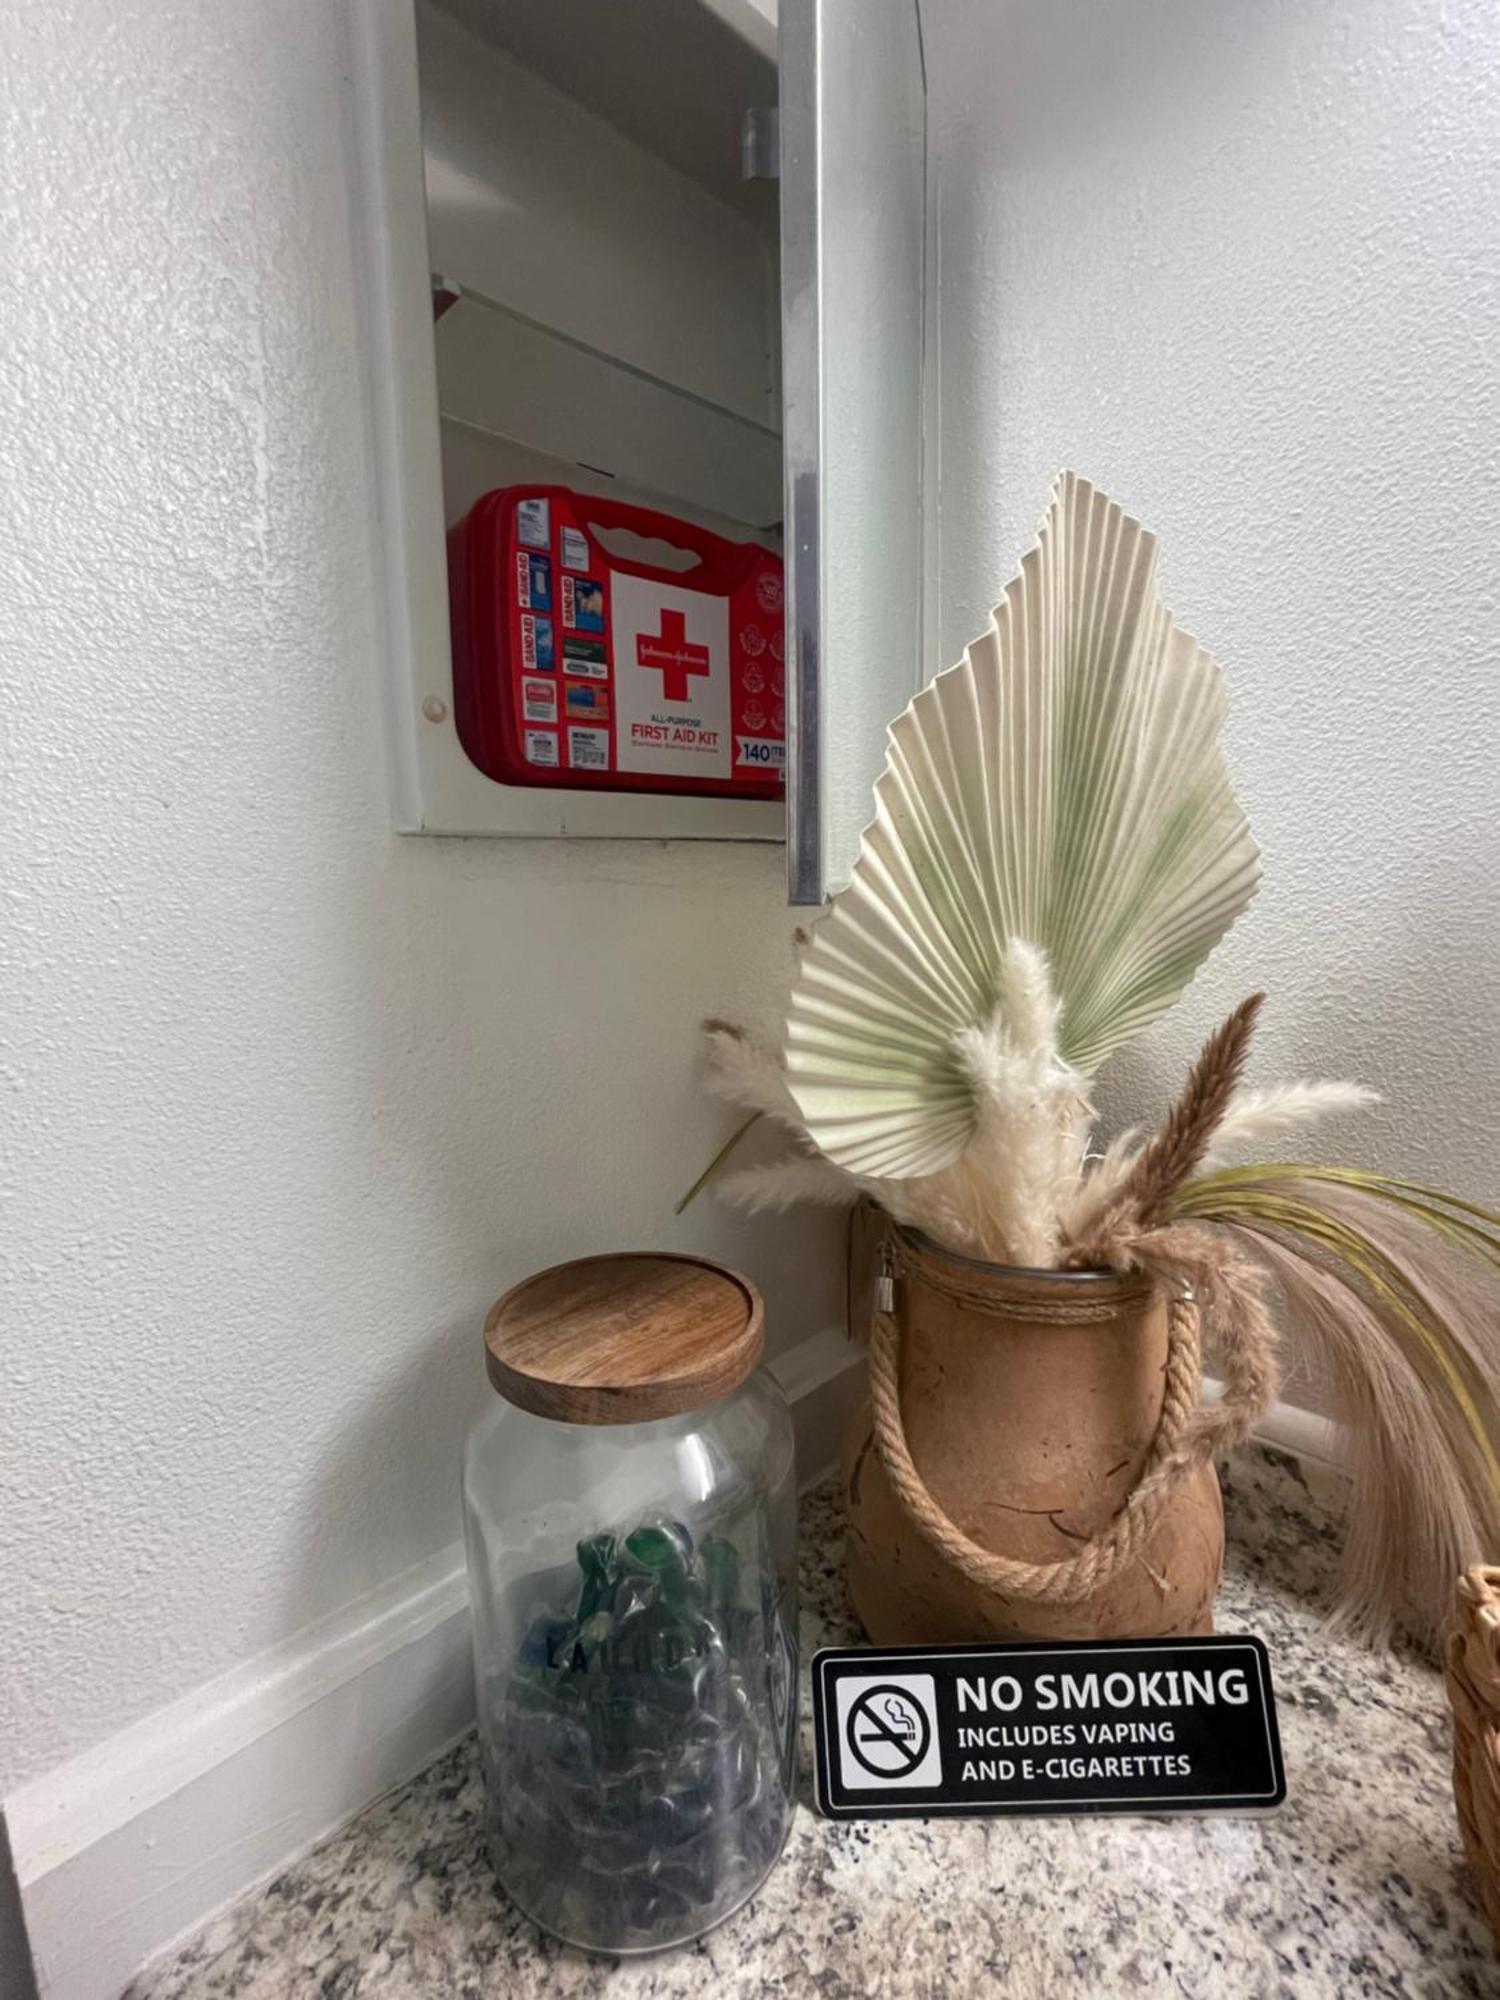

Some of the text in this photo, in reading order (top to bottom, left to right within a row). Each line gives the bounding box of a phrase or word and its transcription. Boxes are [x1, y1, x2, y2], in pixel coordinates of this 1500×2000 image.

[631, 723, 719, 746] FIRST AID KIT
[743, 743, 770, 762] 140
[956, 1668, 1249, 1713] NO SMOKING
[957, 1721, 1175, 1748] INCLUDES VAPING
[961, 1754, 1191, 1782] AND E-CIGARETTES
